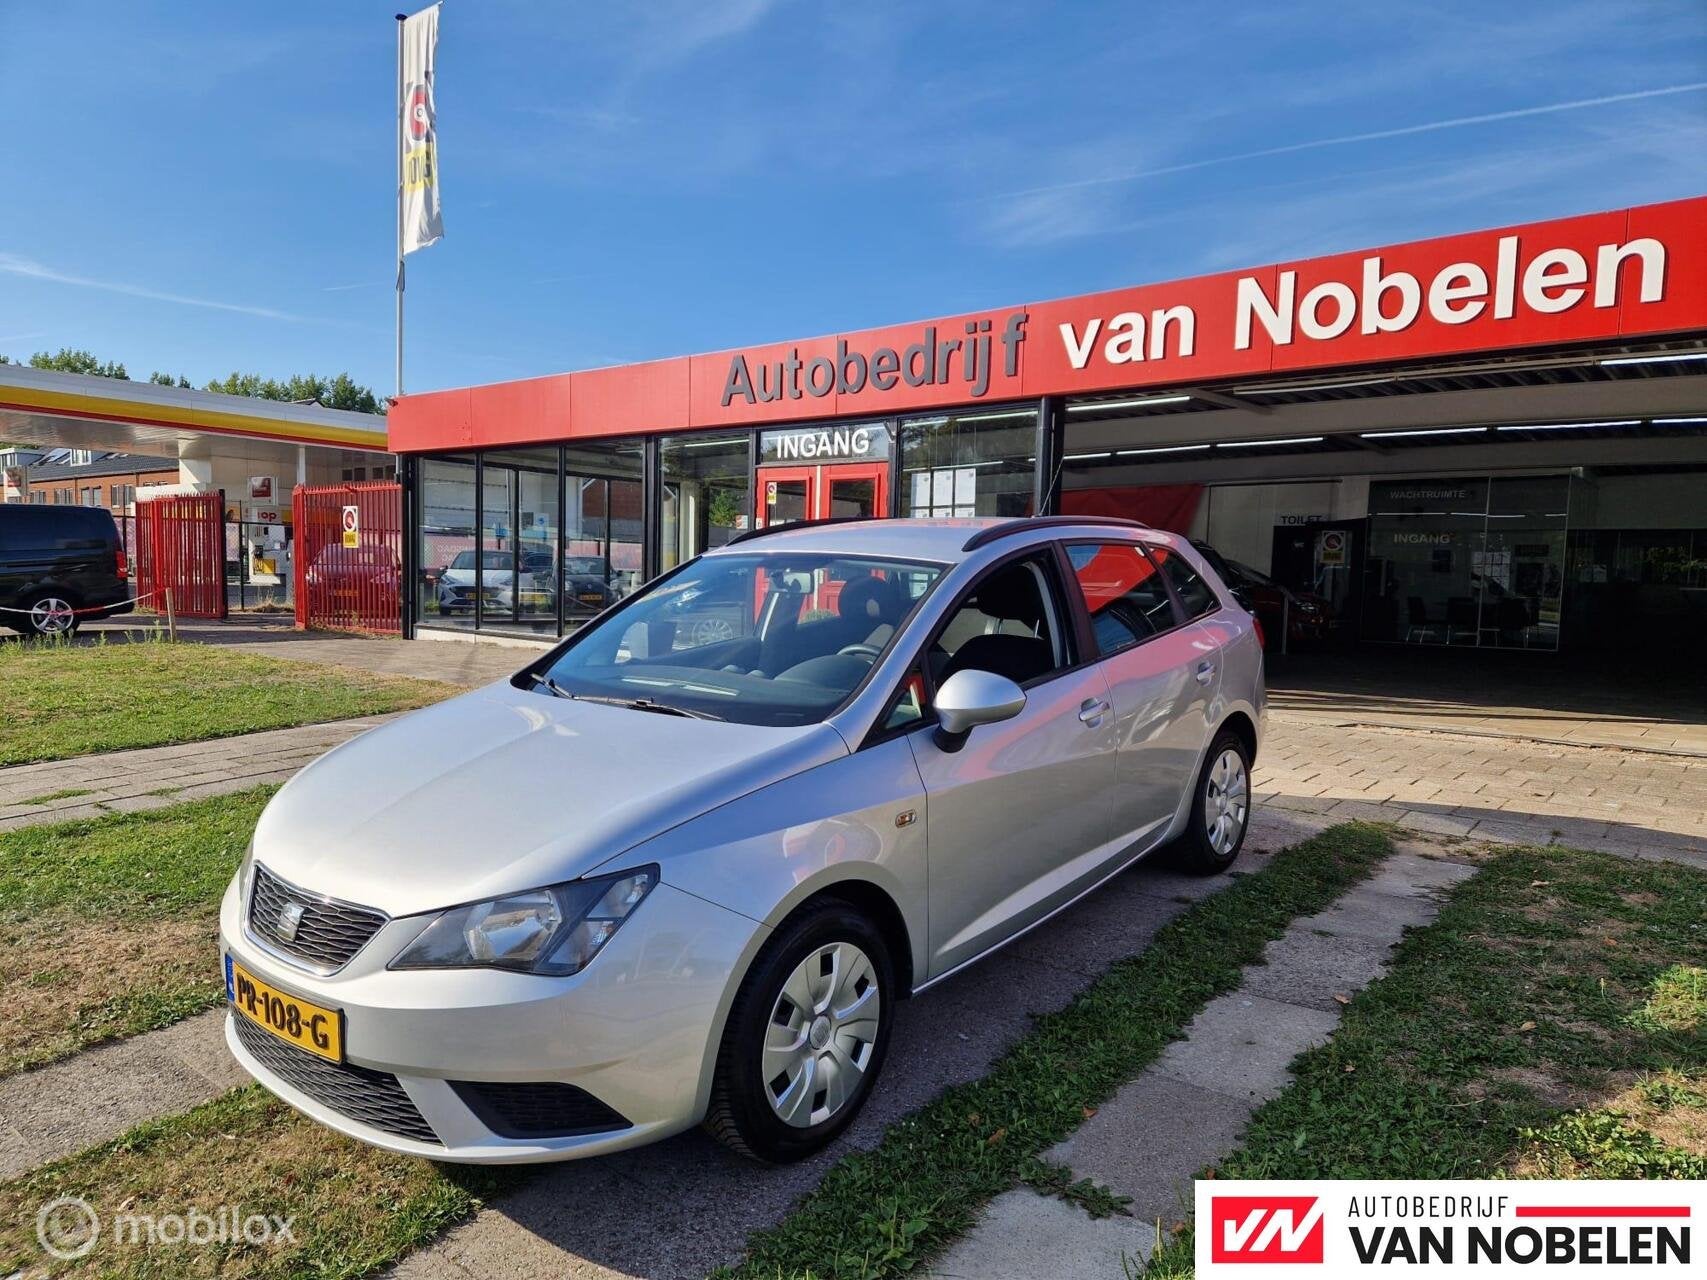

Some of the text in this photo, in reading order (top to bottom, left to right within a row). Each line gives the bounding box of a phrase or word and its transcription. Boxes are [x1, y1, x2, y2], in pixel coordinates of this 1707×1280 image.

[721, 236, 1666, 407] Autobedrijf van Nobelen
[777, 428, 870, 459] INGANG
[1390, 489, 1466, 499] WACHTRUIMTE
[1393, 533, 1450, 544] INGANG
[236, 972, 330, 1050] PR-108-G
